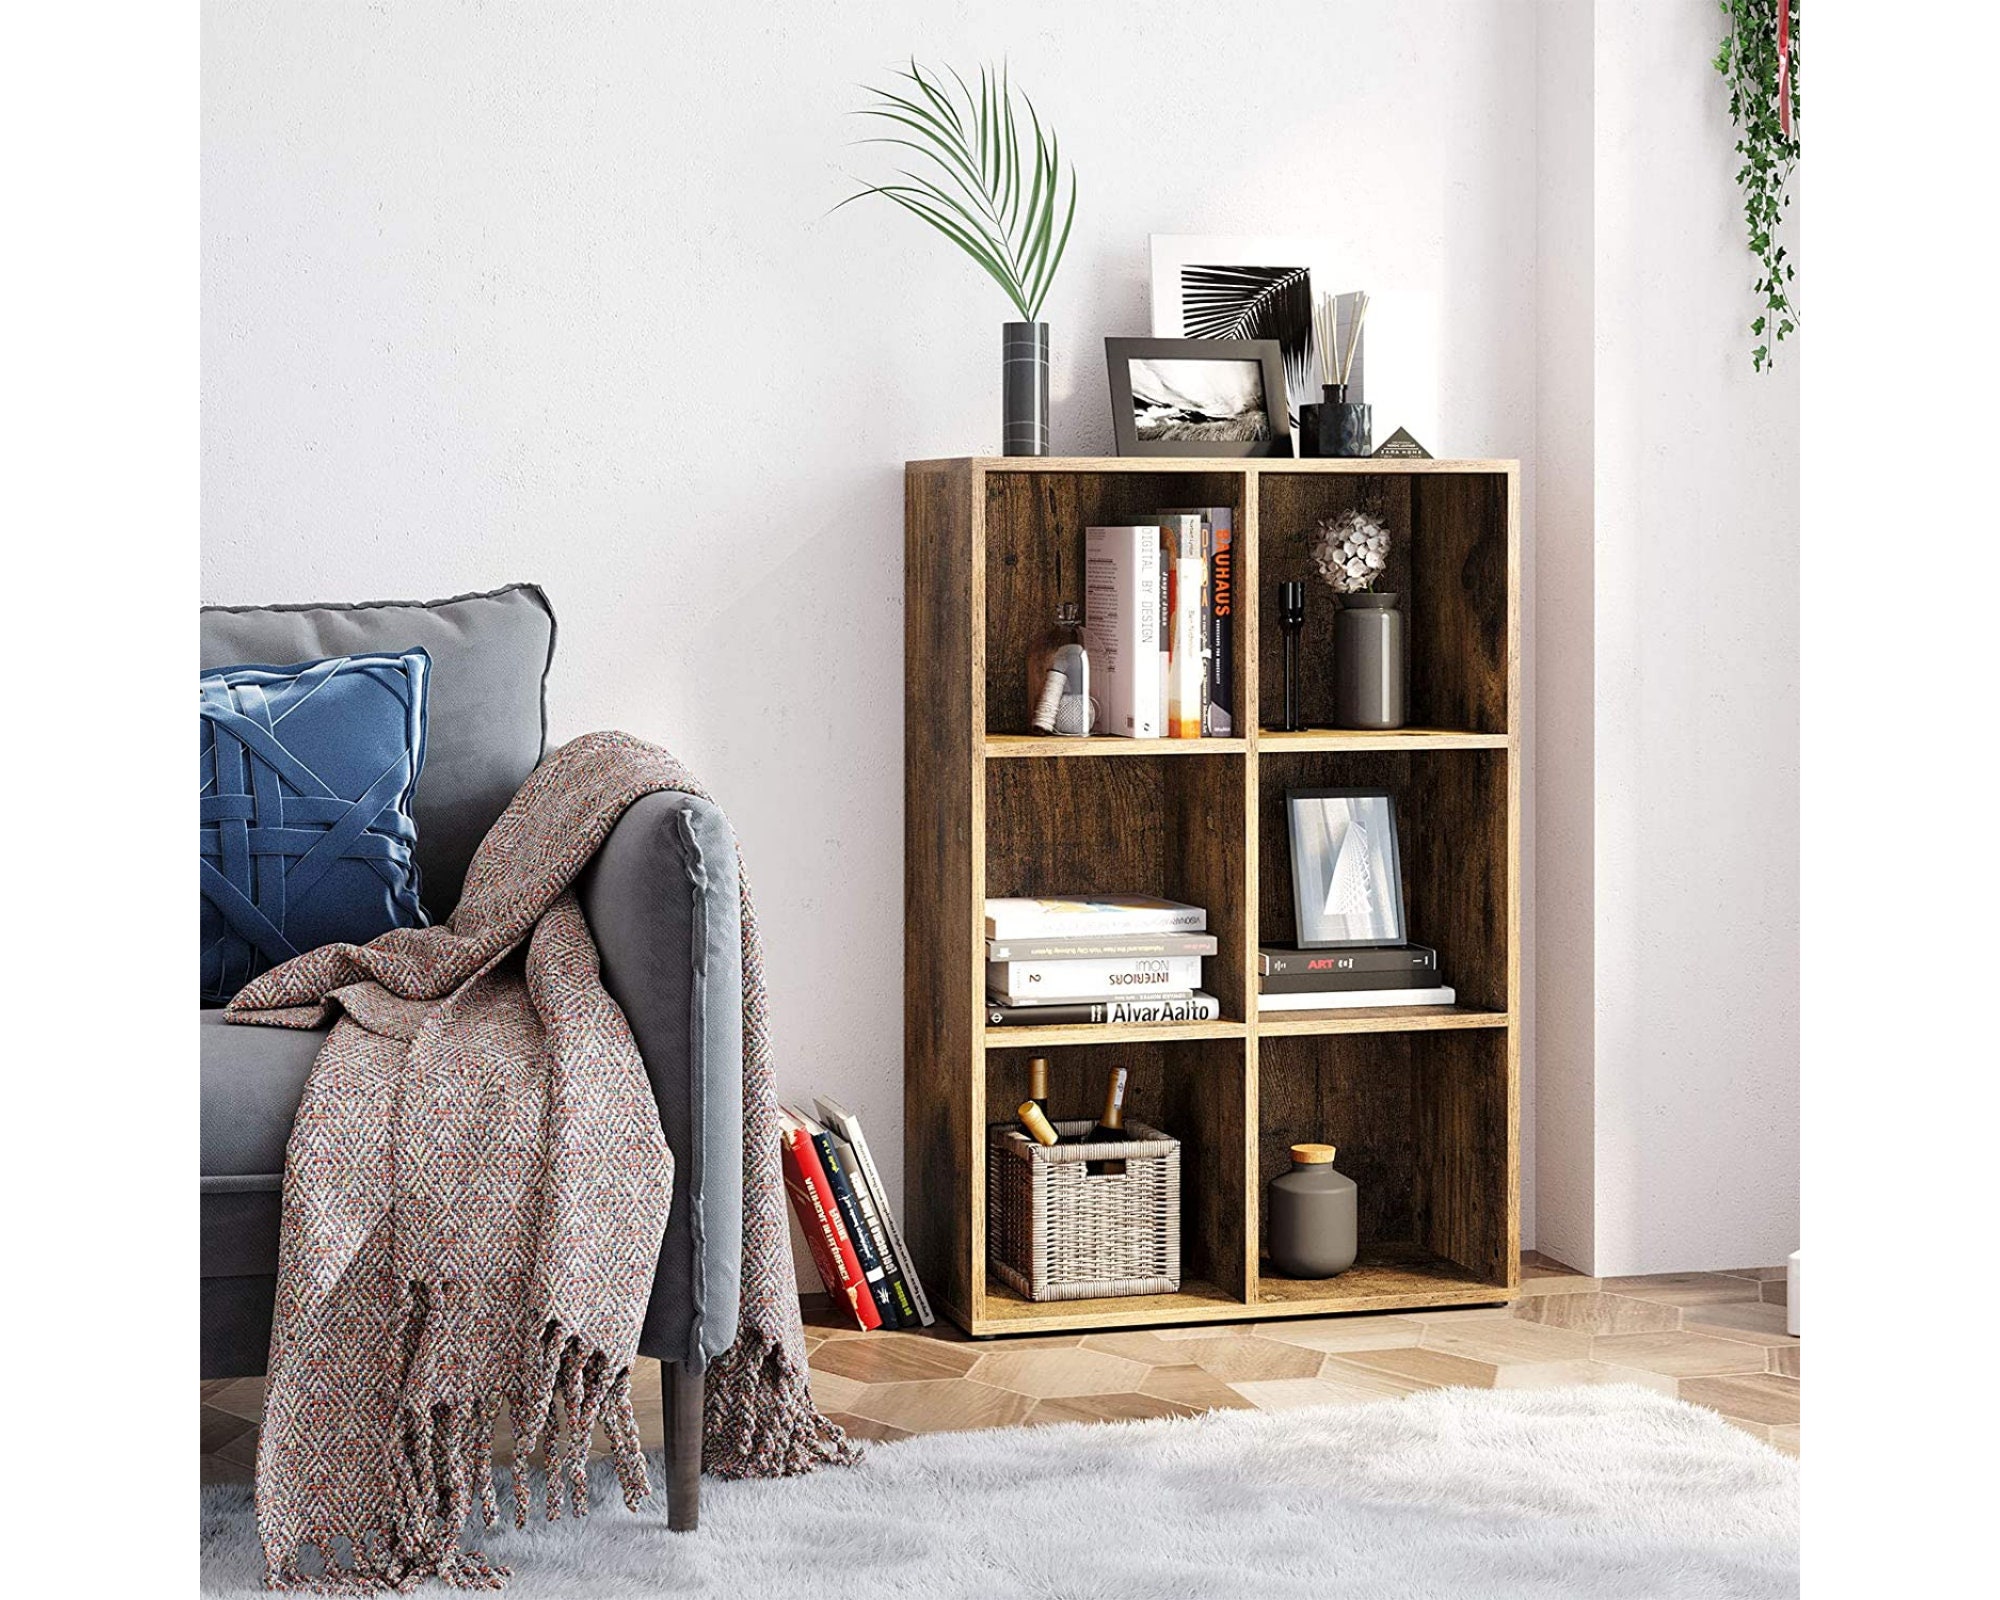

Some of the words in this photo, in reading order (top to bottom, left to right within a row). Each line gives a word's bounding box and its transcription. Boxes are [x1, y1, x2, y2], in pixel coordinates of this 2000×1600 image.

[1142, 528, 1153, 571] DIGITAL
[1215, 529, 1230, 616] BAUHAUS
[1142, 581, 1153, 594] BY
[1142, 601, 1153, 643] DESIGN
[1307, 959, 1334, 970] ART
[1029, 975, 1041, 983] 2
[1109, 973, 1169, 985] INTERIORS
[1112, 1004, 1160, 1023] Alvar
[1163, 1002, 1209, 1021] Aalto
